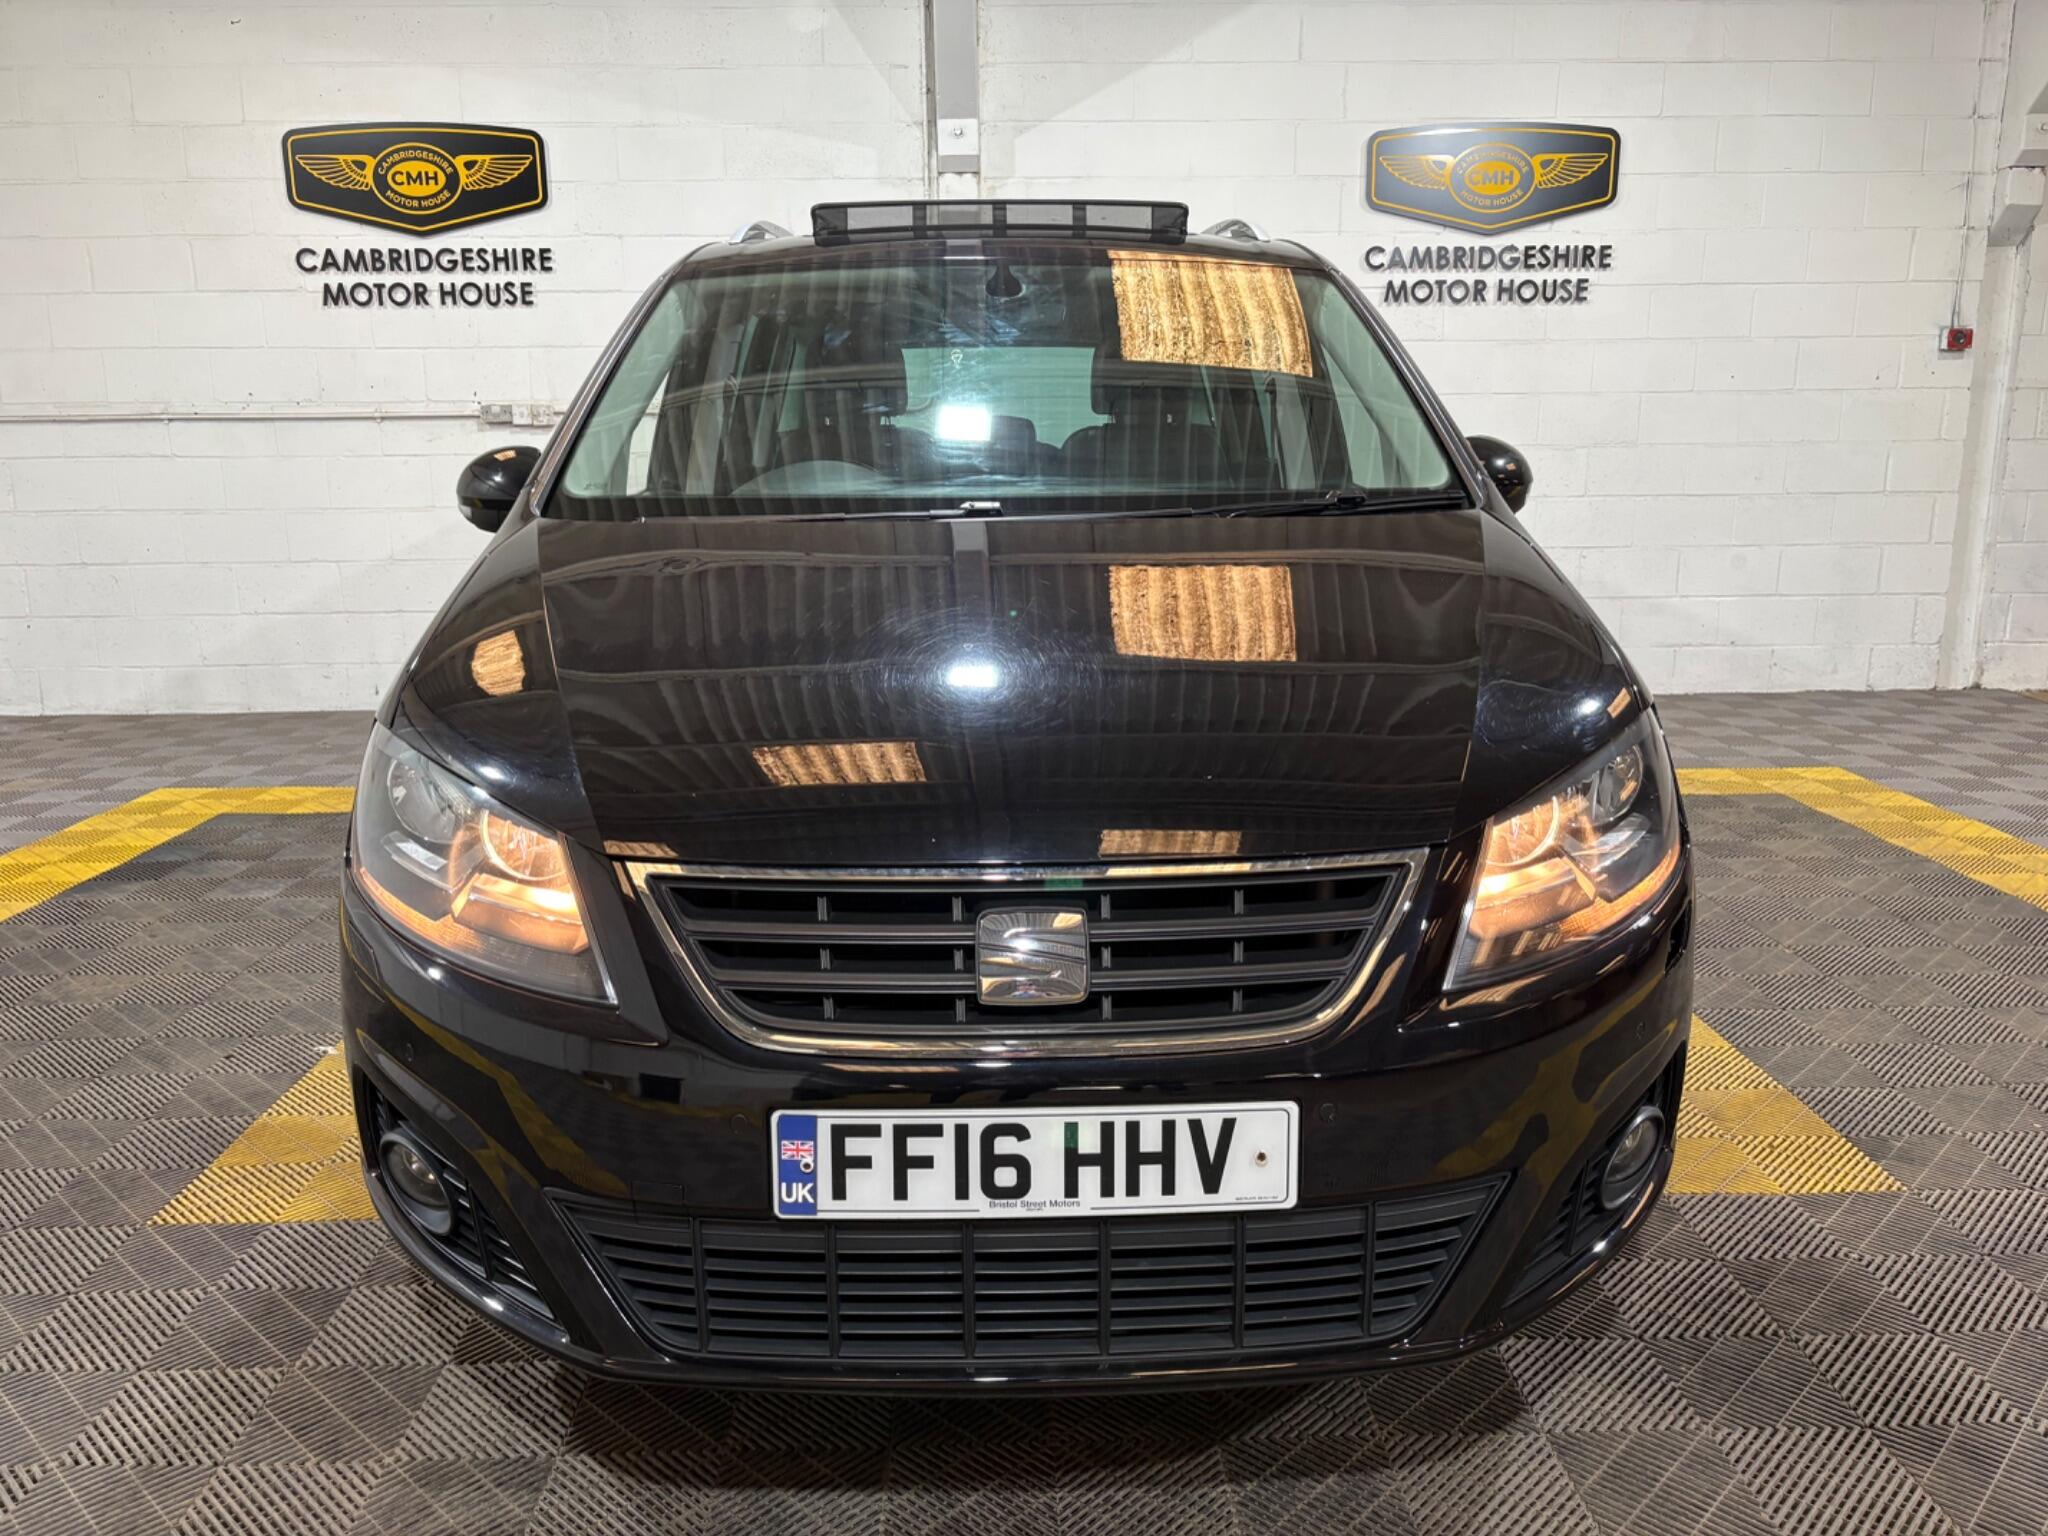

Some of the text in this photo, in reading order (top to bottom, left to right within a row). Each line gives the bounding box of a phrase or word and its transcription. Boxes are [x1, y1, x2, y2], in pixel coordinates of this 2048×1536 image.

[378, 150, 454, 175] CAMBRIDGESHIRE
[391, 170, 439, 186] CMH
[1468, 170, 1514, 186] CMH
[385, 189, 451, 208] MOTOR HOUSE
[1493, 189, 1524, 206] HOUSE
[296, 248, 553, 273] CAMBRIDGESHIRE
[1365, 245, 1613, 270] CAMBRIDGESHIRE
[322, 282, 535, 307] MOTOR HOUSE
[1384, 278, 1590, 303] MOTOR HOUSE
[830, 1117, 1237, 1201] FF16 HHV
[781, 1182, 814, 1204] UK
[989, 1199, 1081, 1209] Bristol Street Motors
